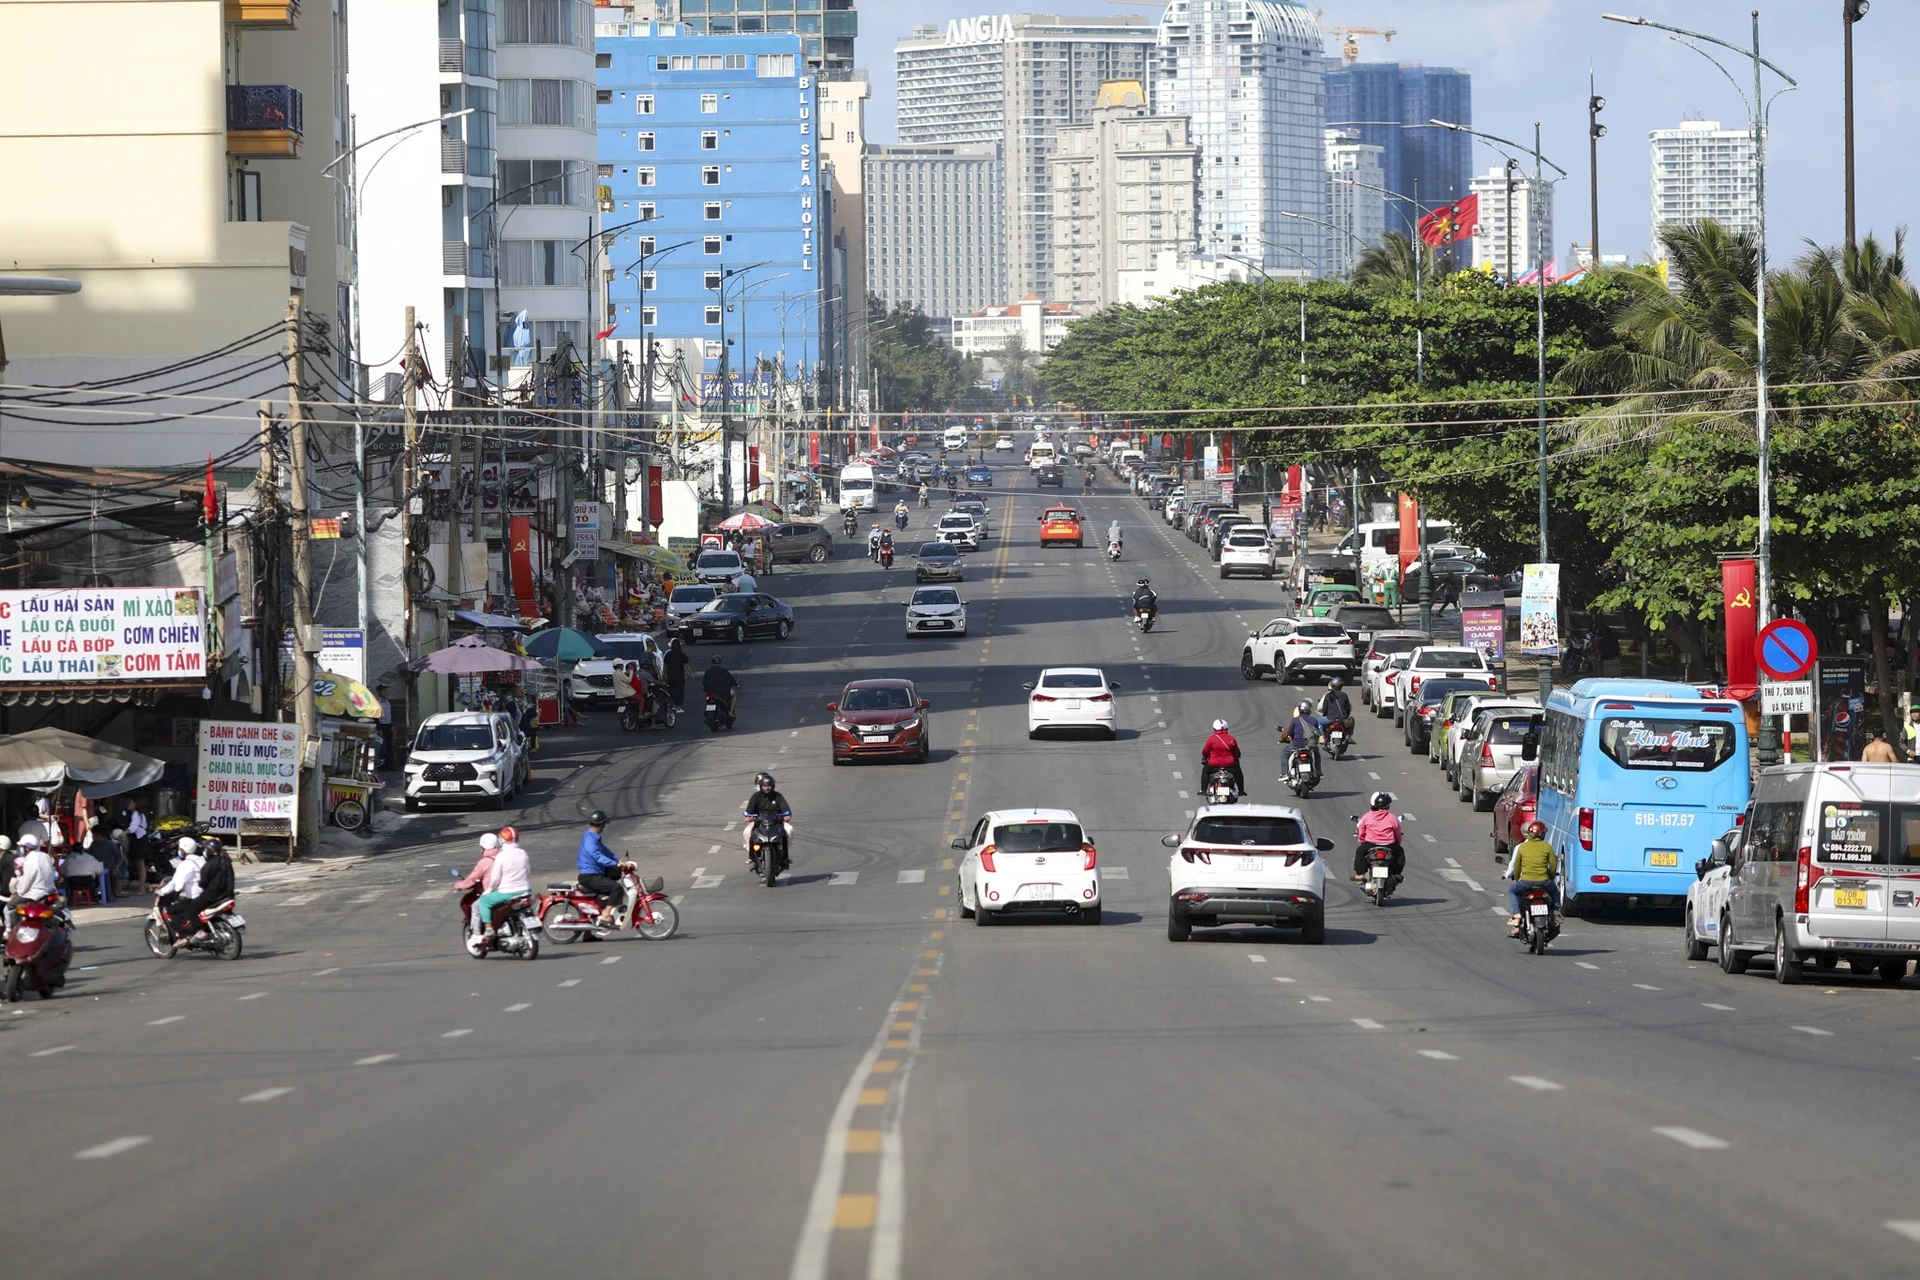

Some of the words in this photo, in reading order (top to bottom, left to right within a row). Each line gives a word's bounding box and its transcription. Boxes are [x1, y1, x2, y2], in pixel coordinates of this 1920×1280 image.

[799, 77, 810, 135] BLUE
[801, 144, 811, 186] SEA
[801, 197, 812, 271] HOTEL
[21, 594, 49, 612] LẨU
[54, 595, 78, 612] HẢI
[84, 594, 114, 611] SẢN
[123, 596, 140, 617] MÌ
[145, 596, 173, 616] XÀO
[22, 614, 50, 633] LẨU
[55, 616, 75, 632] CÁ
[79, 614, 114, 632] ĐUỐI
[124, 625, 154, 644] CƠM
[159, 622, 199, 643] CHIÊN
[22, 635, 51, 653] LẨU
[57, 637, 78, 653] CÁ
[83, 636, 115, 652] BỚP
[22, 655, 52, 673] LẨU
[59, 657, 94, 673] THÁI
[124, 653, 160, 672] CƠM
[166, 647, 200, 671] TẤM
[210, 724, 233, 738] BÁNH
[236, 726, 259, 740] CANH
[262, 728, 278, 743] GHẸ
[1627, 729, 1669, 746] Kim
[210, 740, 225, 756] HỦ
[228, 741, 250, 757] TIẾU
[254, 745, 278, 760] MỰC
[209, 759, 232, 774] CHÁO
[257, 762, 277, 778] MỰC
[209, 778, 228, 793] BÚN
[231, 779, 253, 794] RIÊU
[256, 780, 276, 794] TÔM
[208, 794, 228, 811] LẨU
[232, 796, 249, 812] HẢI
[253, 797, 276, 813] SẢN
[209, 815, 237, 829] CƠM
[1635, 813, 1695, 827] 51B-197.67
